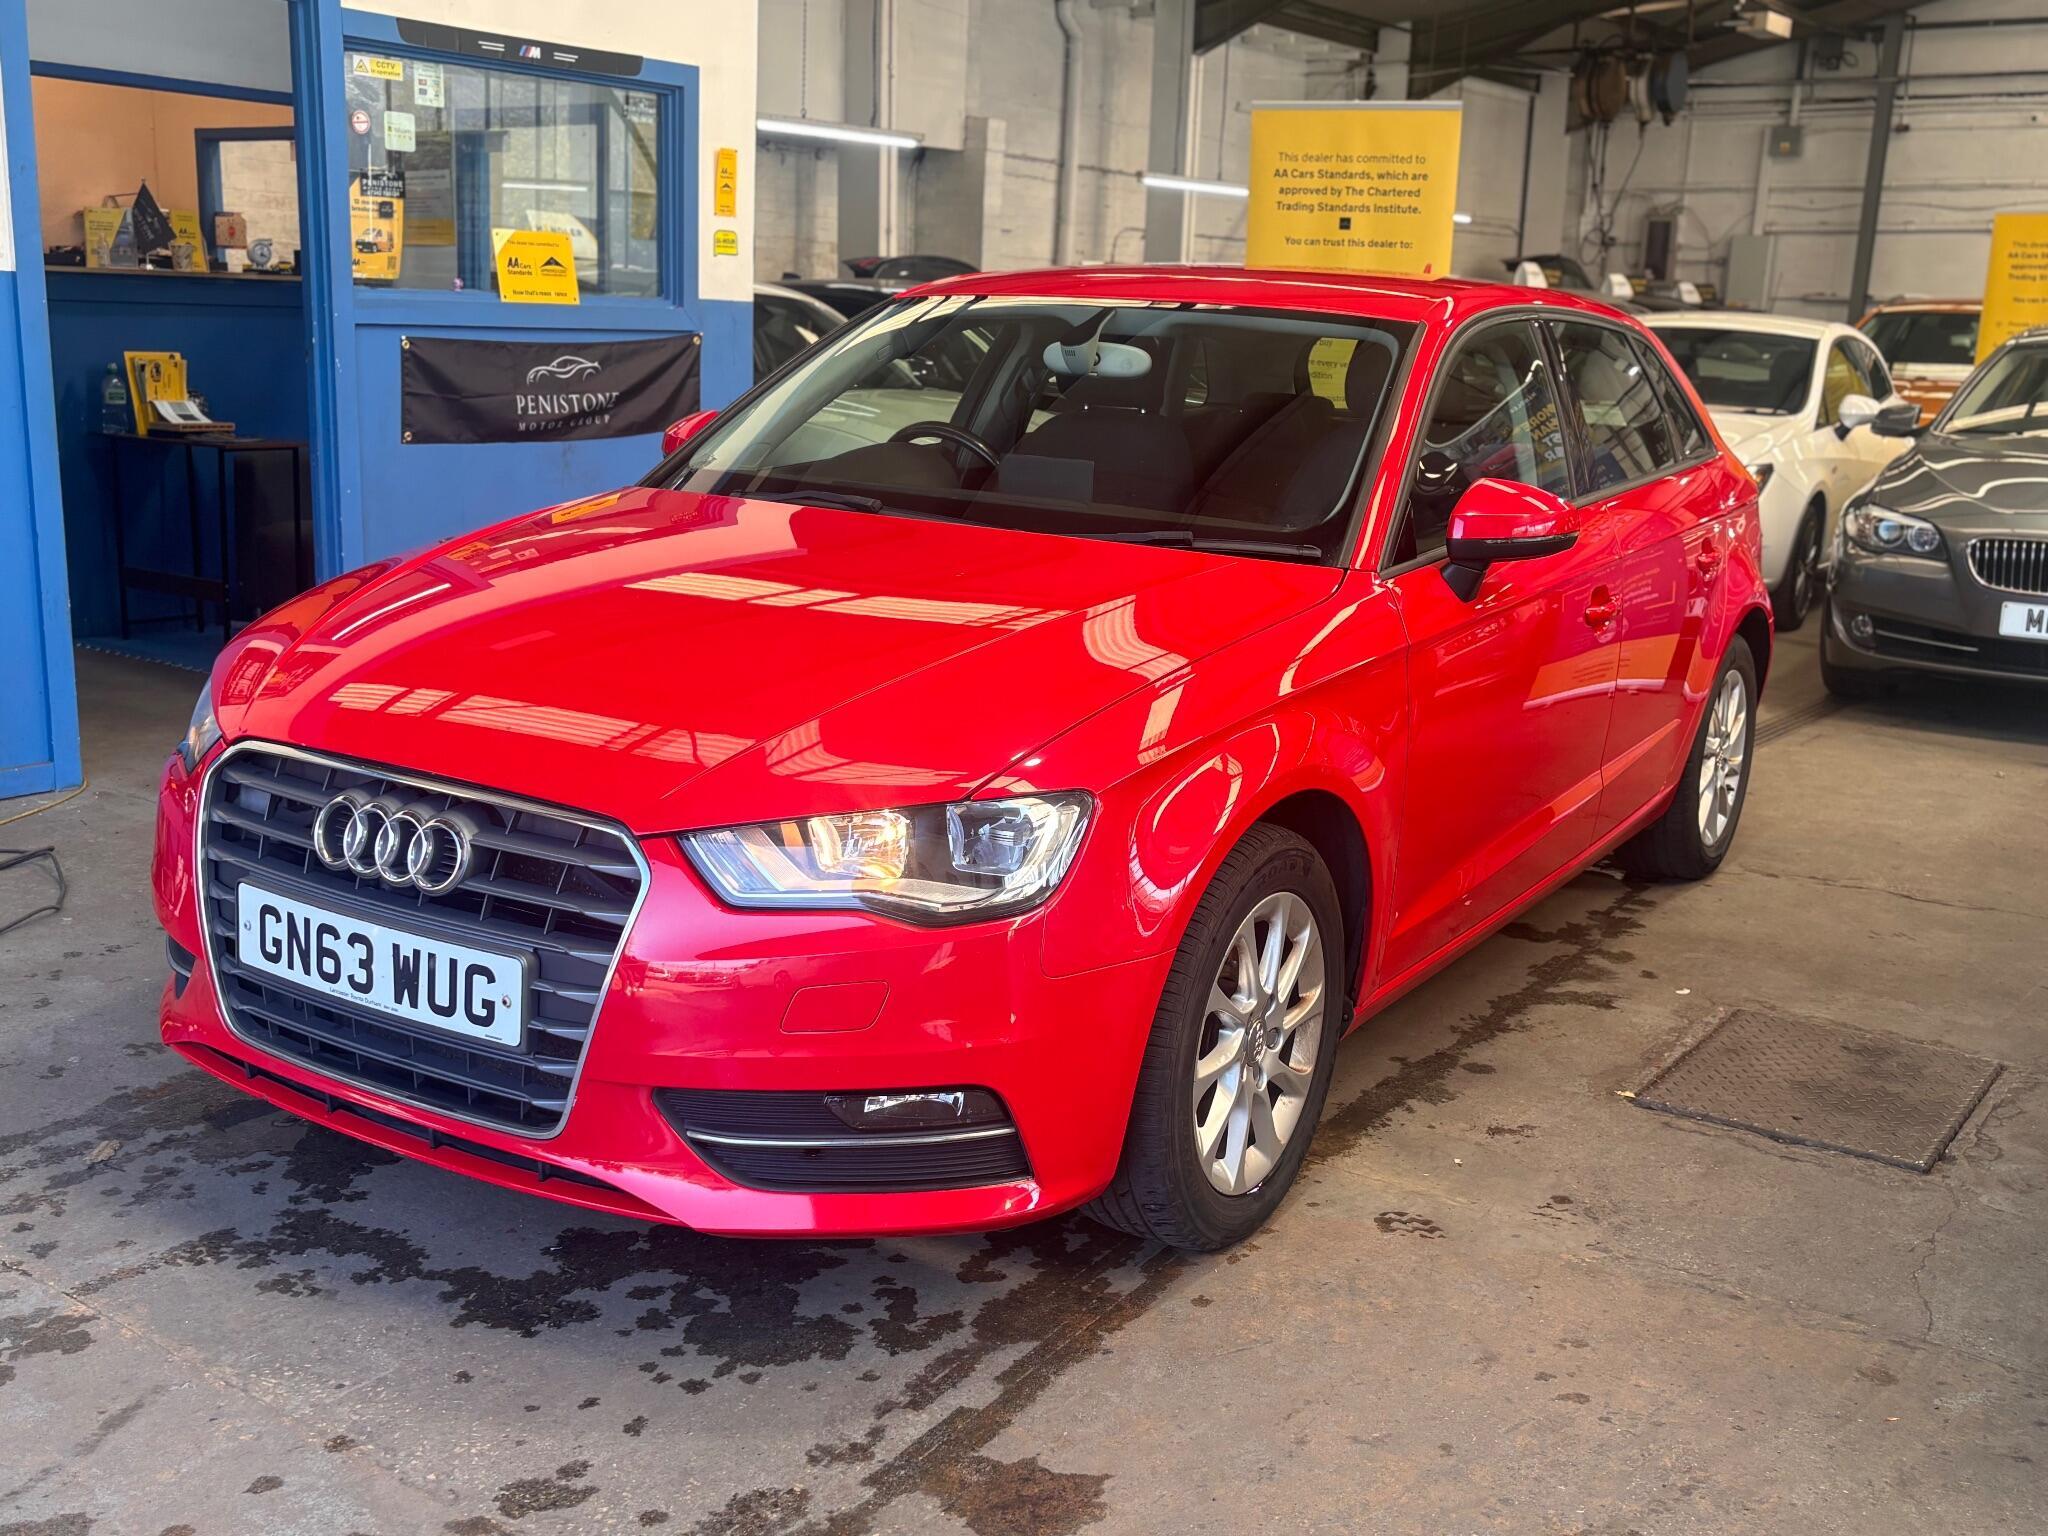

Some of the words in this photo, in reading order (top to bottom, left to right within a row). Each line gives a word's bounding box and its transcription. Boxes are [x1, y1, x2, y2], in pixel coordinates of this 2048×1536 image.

[375, 60, 396, 70] CCTV
[1278, 152, 1299, 163] This
[1301, 153, 1333, 164] dealer
[1335, 153, 1355, 164] has
[1356, 154, 1414, 165] committed
[1415, 156, 1426, 165] to
[1273, 168, 1289, 179] AA
[1290, 169, 1315, 180] Cars
[1316, 169, 1374, 182] Standards,
[1376, 171, 1409, 182] which
[1411, 173, 1429, 182] are
[362, 179, 404, 188] PENISTONE
[1278, 186, 1328, 198] approved
[1330, 187, 1343, 198] by
[1345, 187, 1365, 197] The
[1367, 187, 1421, 198] Chartered
[1276, 201, 1315, 213] Trading
[1316, 202, 1371, 213] Standards
[1373, 203, 1422, 215] Institute.
[1284, 236, 1302, 247] You
[1303, 238, 1321, 247] can
[1322, 237, 1346, 248] trust
[1347, 238, 1366, 248] this
[1367, 238, 1397, 249] dealer
[1398, 240, 1414, 249] to:
[507, 256, 520, 269] AA
[1315, 360, 1338, 369] every
[516, 392, 619, 415] PENISTONE
[517, 421, 563, 432] MOTOR
[258, 903, 374, 996] GN63
[391, 943, 497, 1028] WUG
